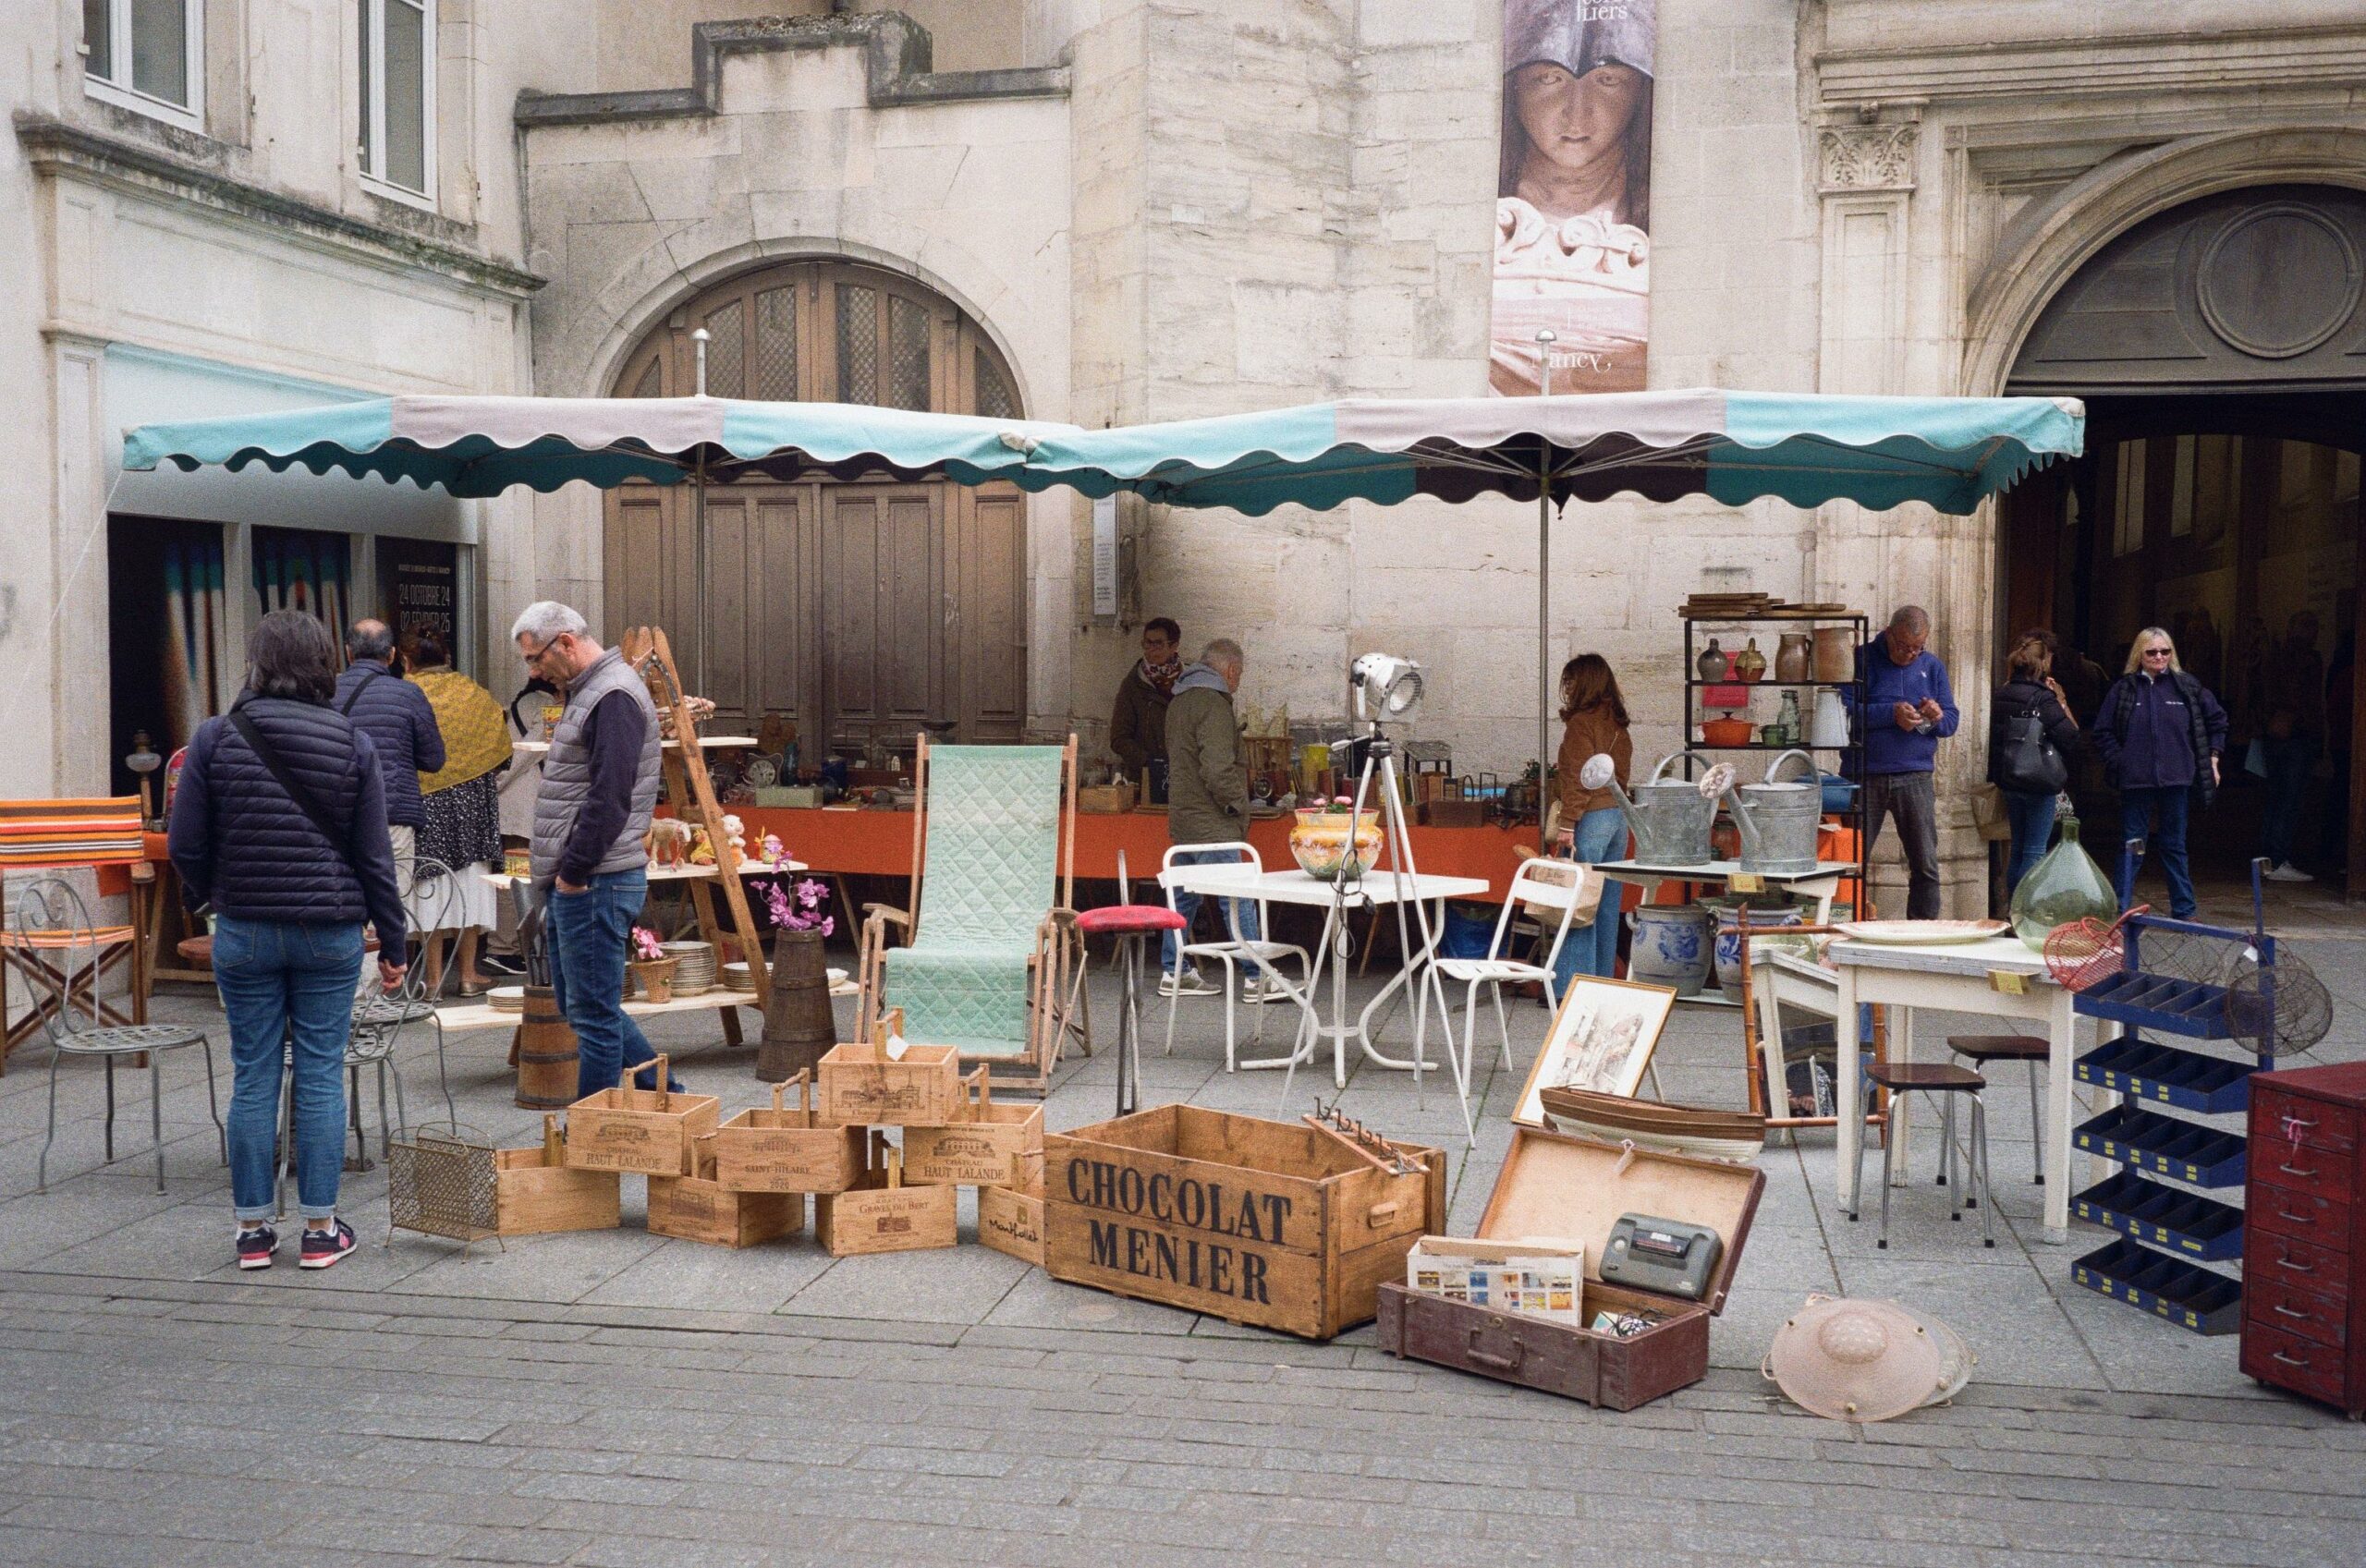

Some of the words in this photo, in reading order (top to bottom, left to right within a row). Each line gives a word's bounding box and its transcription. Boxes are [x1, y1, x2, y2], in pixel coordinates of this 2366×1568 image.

[409, 584, 440, 606] OCTOBRE
[441, 585, 450, 606] 24
[586, 1152, 612, 1165] HAUT
[617, 1155, 663, 1169] LALANDE
[744, 1165, 811, 1174] SAINT-HILAIRE
[924, 1166, 952, 1178] HAUT
[957, 1169, 1005, 1180] LALANDE
[908, 1200, 930, 1210] BERT
[1067, 1158, 1293, 1246] CHOCOLAT
[1089, 1218, 1273, 1306] MENIER
